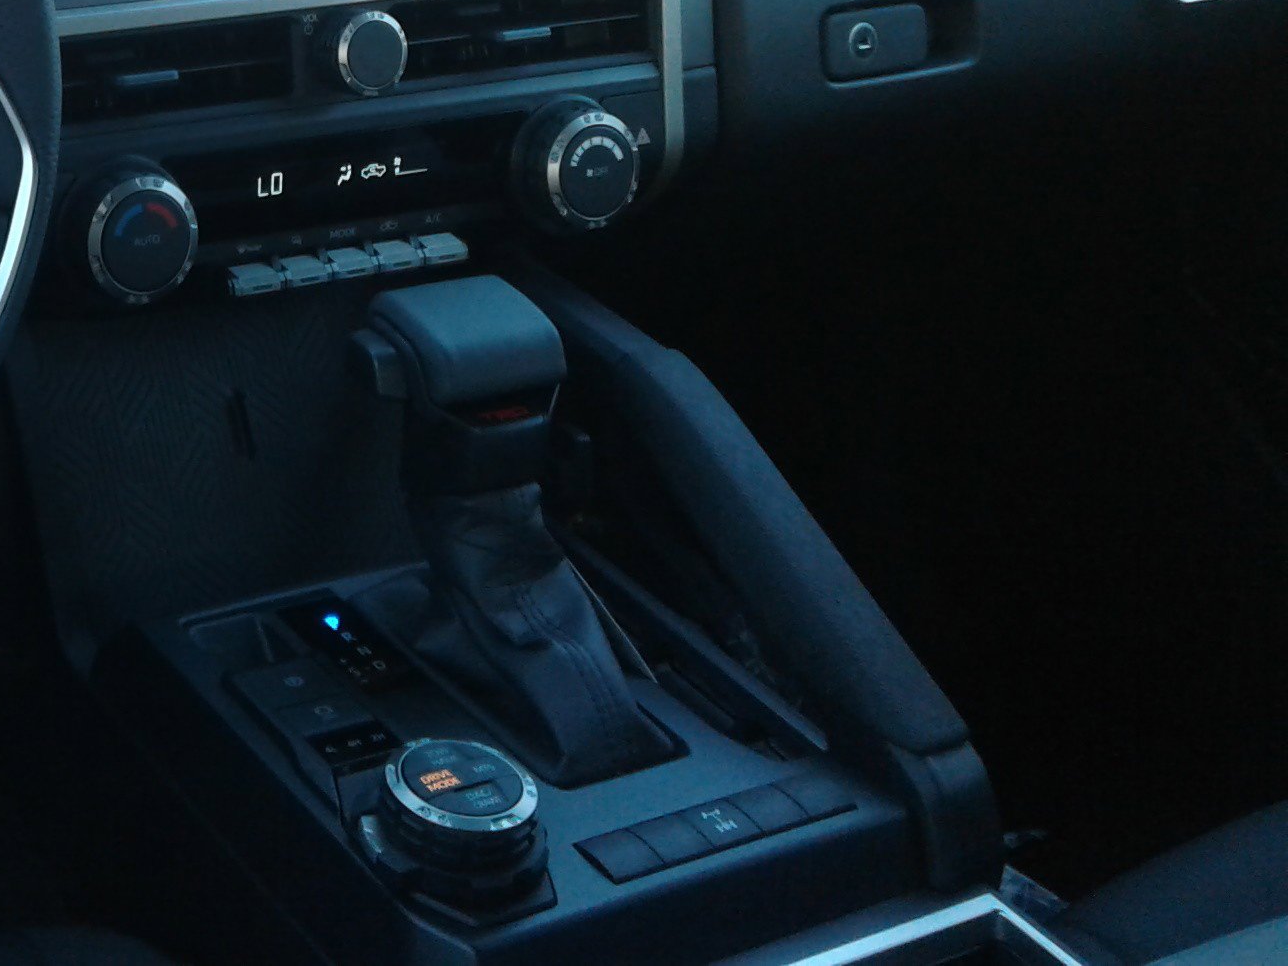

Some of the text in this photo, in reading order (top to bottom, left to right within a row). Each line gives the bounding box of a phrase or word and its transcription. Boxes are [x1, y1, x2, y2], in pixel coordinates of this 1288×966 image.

[302, 13, 318, 23] VOL
[257, 172, 283, 198] LO
[329, 227, 356, 239] MODE
[134, 234, 161, 247] AUTO
